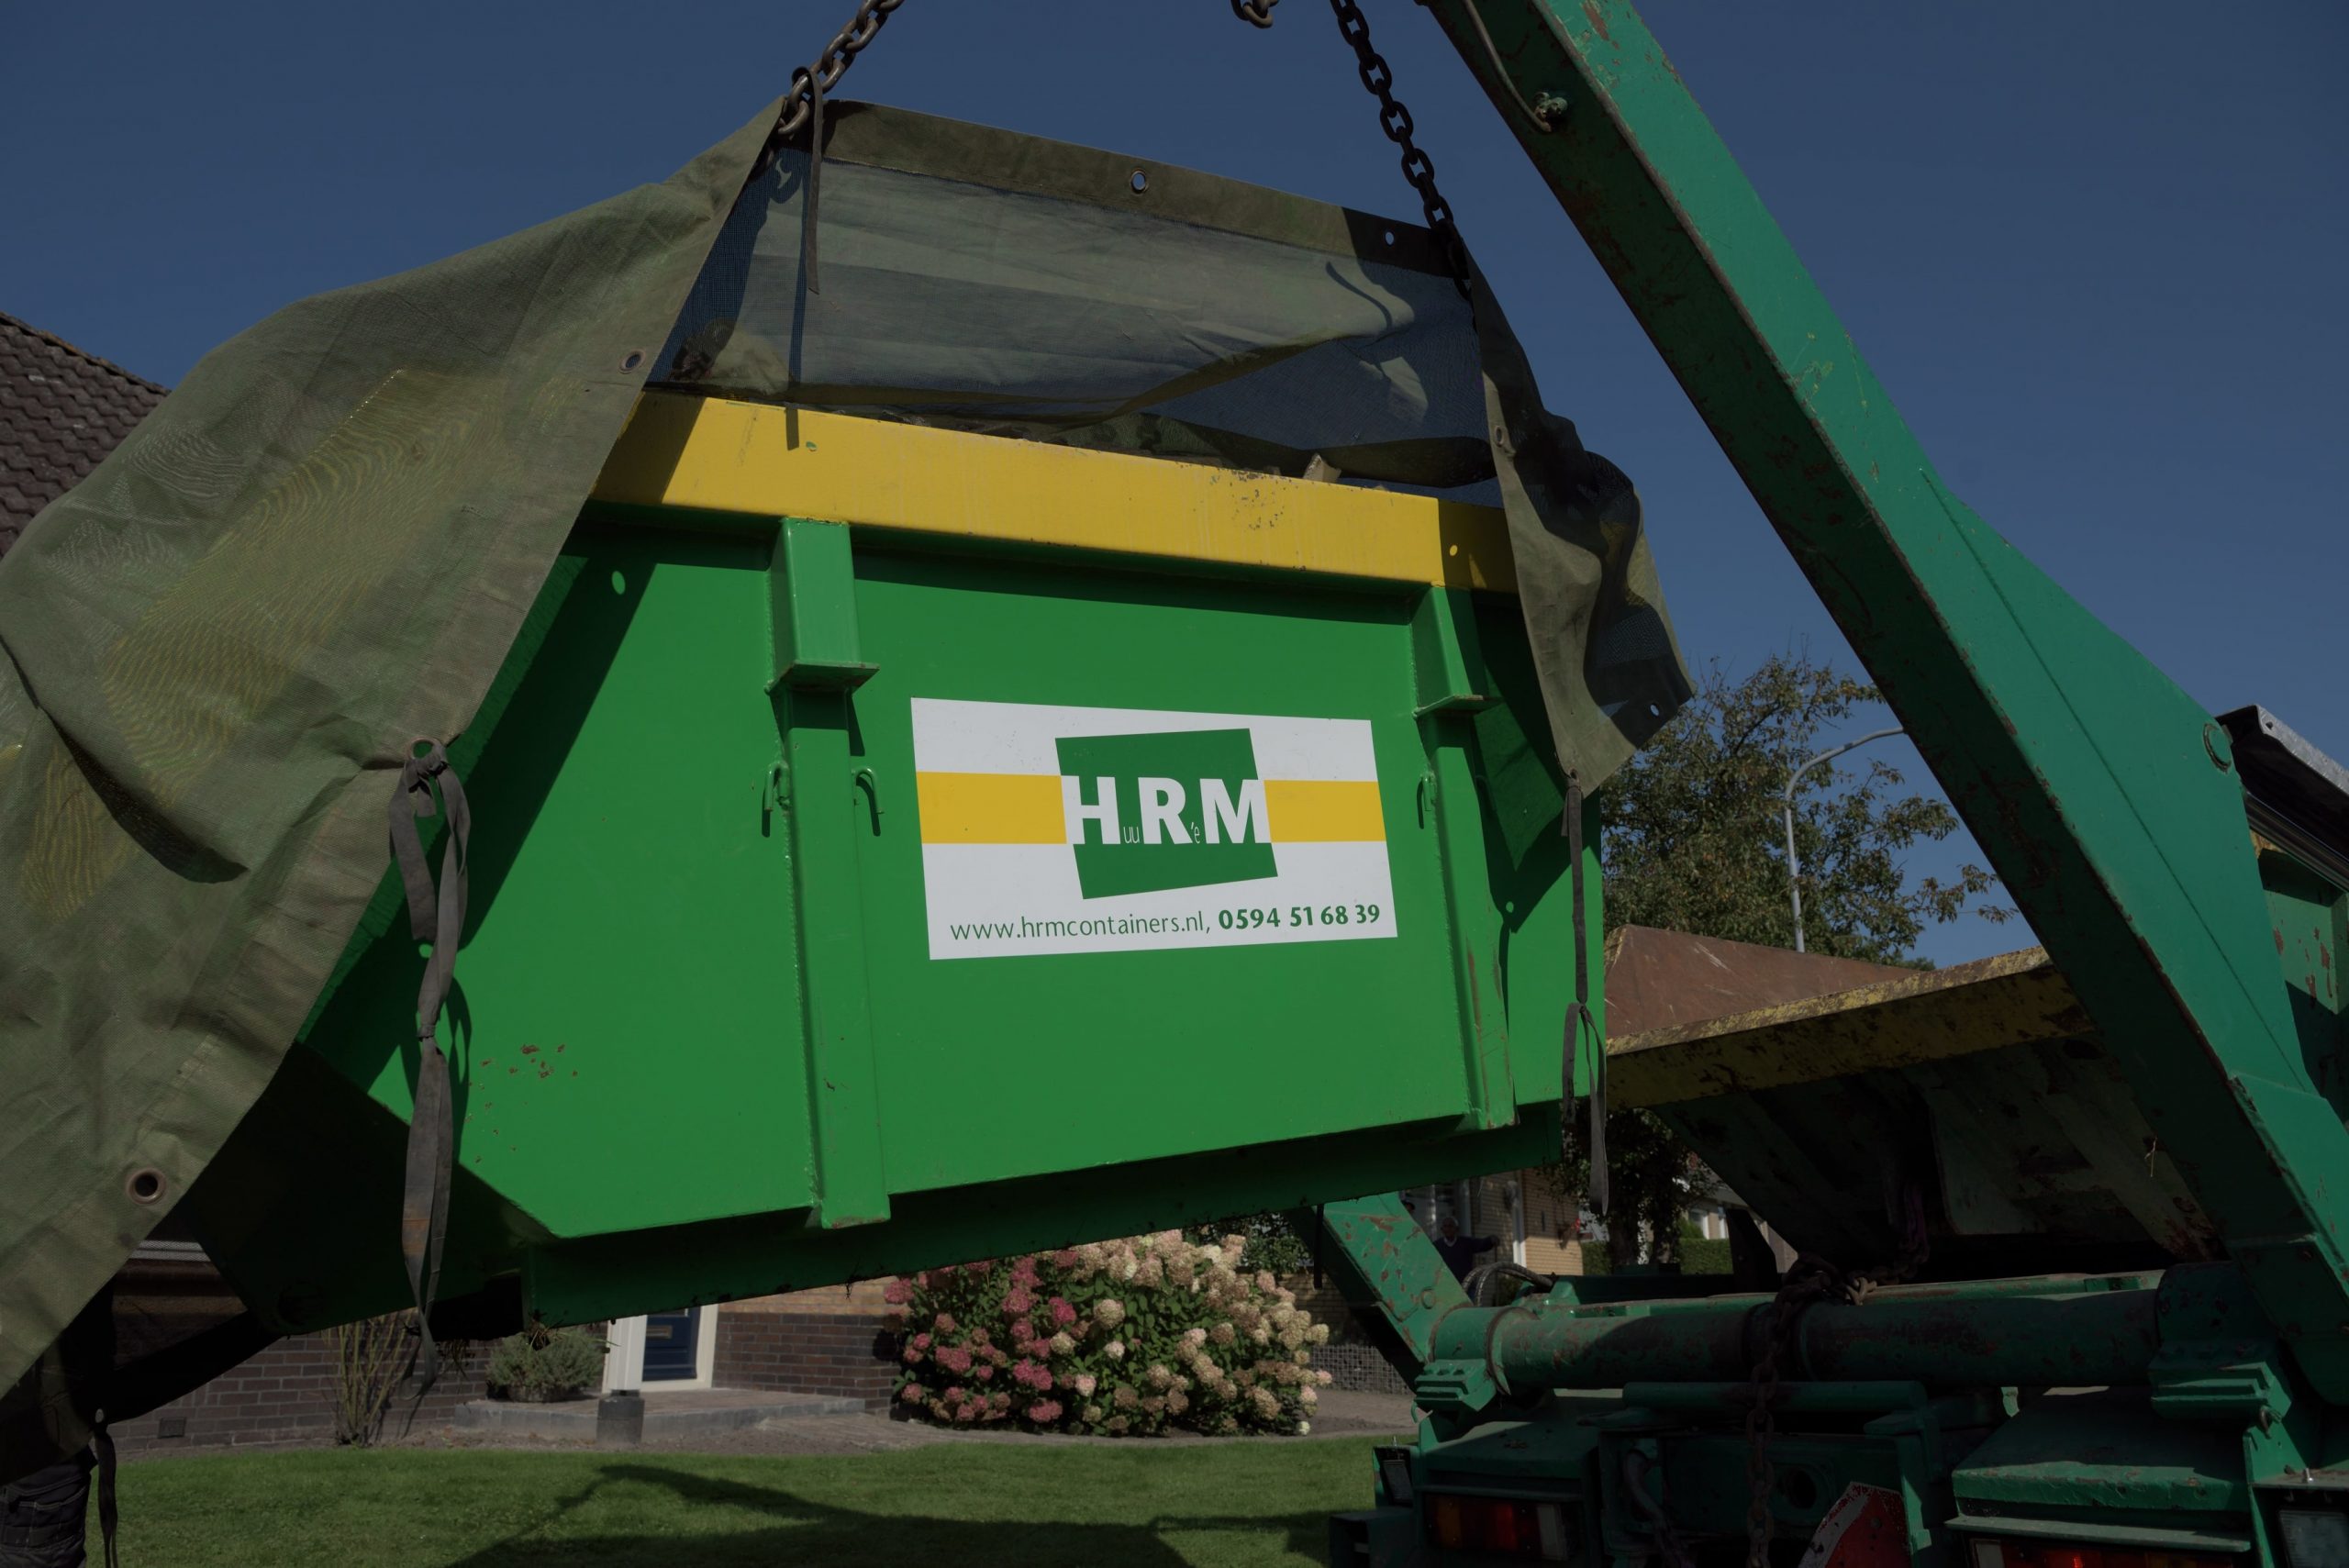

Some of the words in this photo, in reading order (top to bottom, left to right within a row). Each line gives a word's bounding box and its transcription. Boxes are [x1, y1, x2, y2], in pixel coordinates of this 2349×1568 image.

[951, 911, 1210, 940] www.hrmcontainers.nl,
[1219, 907, 1281, 929] 0594
[1290, 906, 1314, 927] 51
[1320, 906, 1349, 925] 68
[1355, 904, 1380, 924] 39
